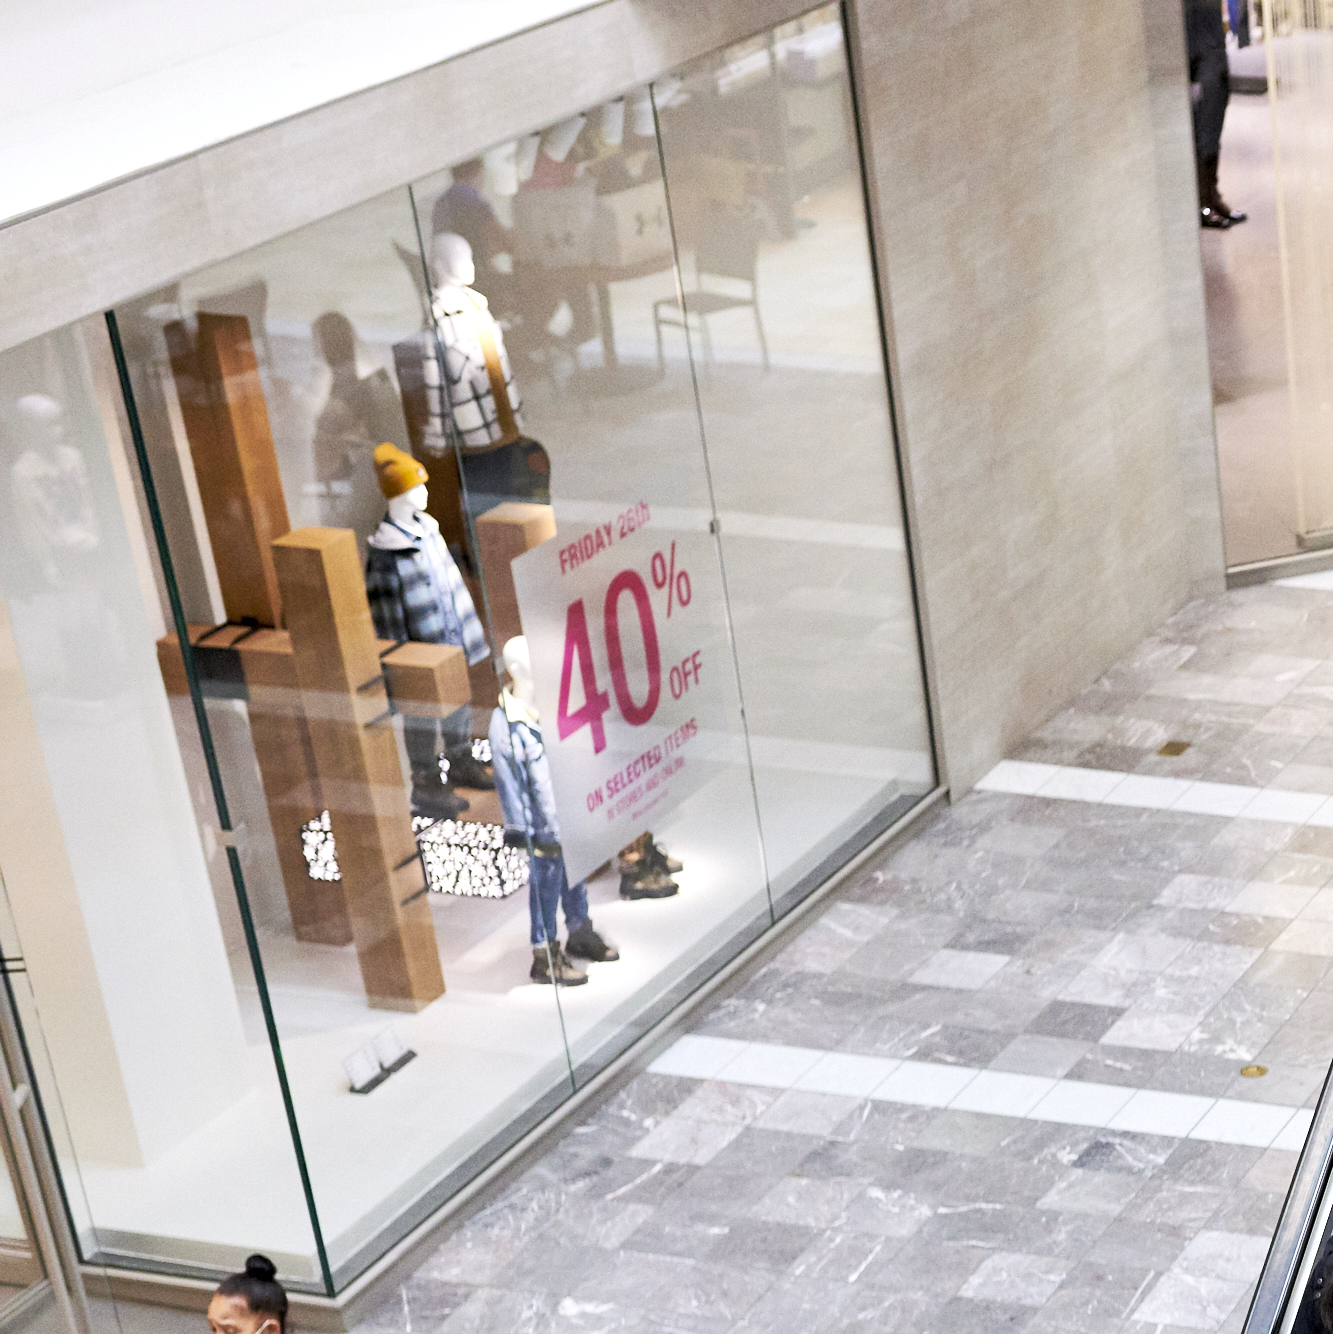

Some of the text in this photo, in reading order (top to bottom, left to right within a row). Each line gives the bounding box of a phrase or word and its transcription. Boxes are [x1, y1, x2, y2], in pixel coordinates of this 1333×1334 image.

[558, 521, 614, 575] FRIDAY
[669, 649, 702, 700] OFF
[586, 785, 604, 813] ON
[605, 743, 662, 799] SELECTED
[663, 716, 699, 755] ITEMS
